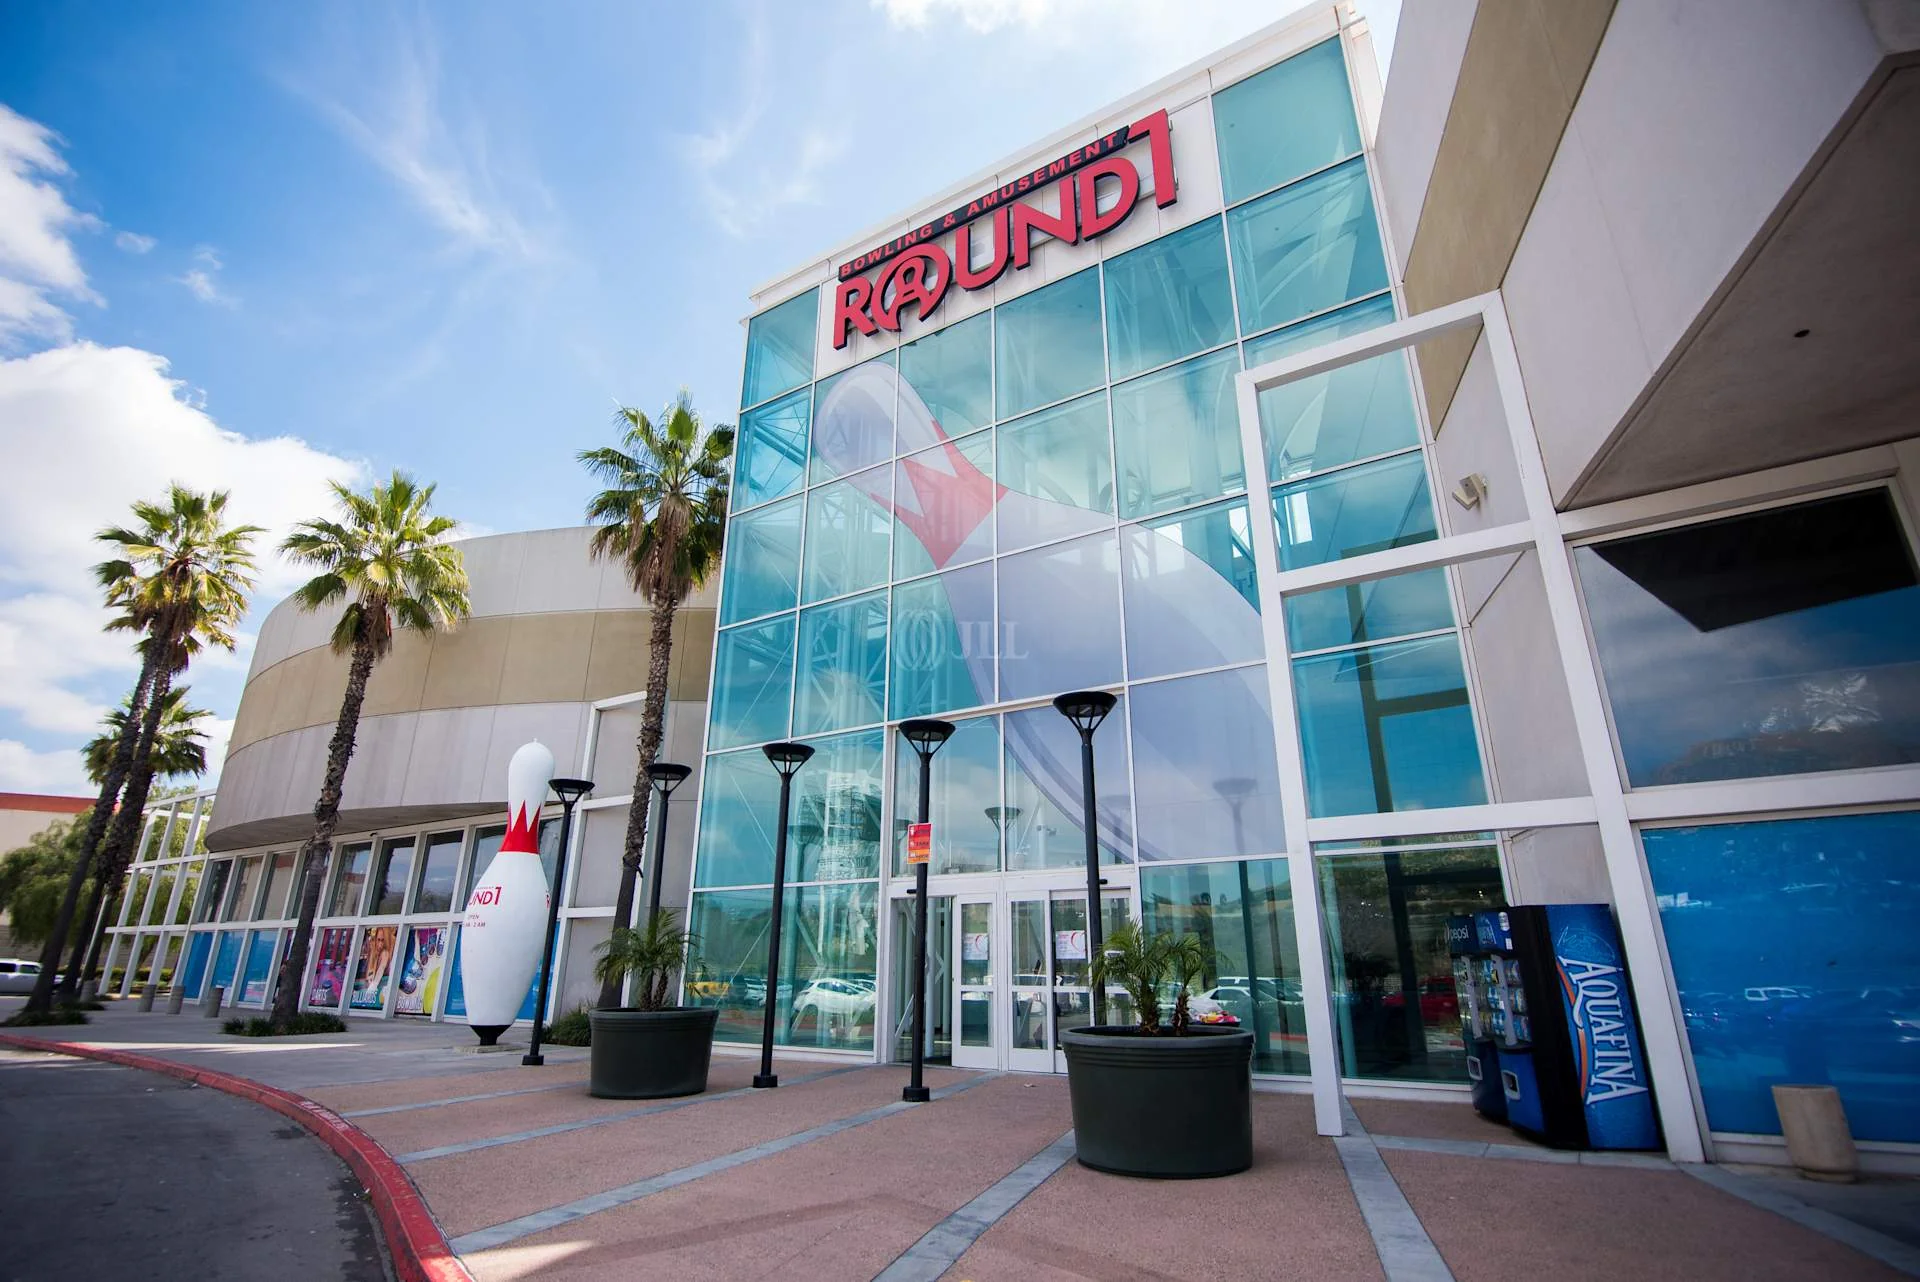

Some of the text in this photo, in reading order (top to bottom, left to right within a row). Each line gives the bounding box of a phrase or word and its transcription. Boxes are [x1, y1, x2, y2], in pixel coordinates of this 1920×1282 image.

[840, 132, 1118, 276] BOWLING & AMUSEMENT
[1449, 924, 1469, 942] pepsi
[1557, 955, 1649, 1105] AQUAFINA
